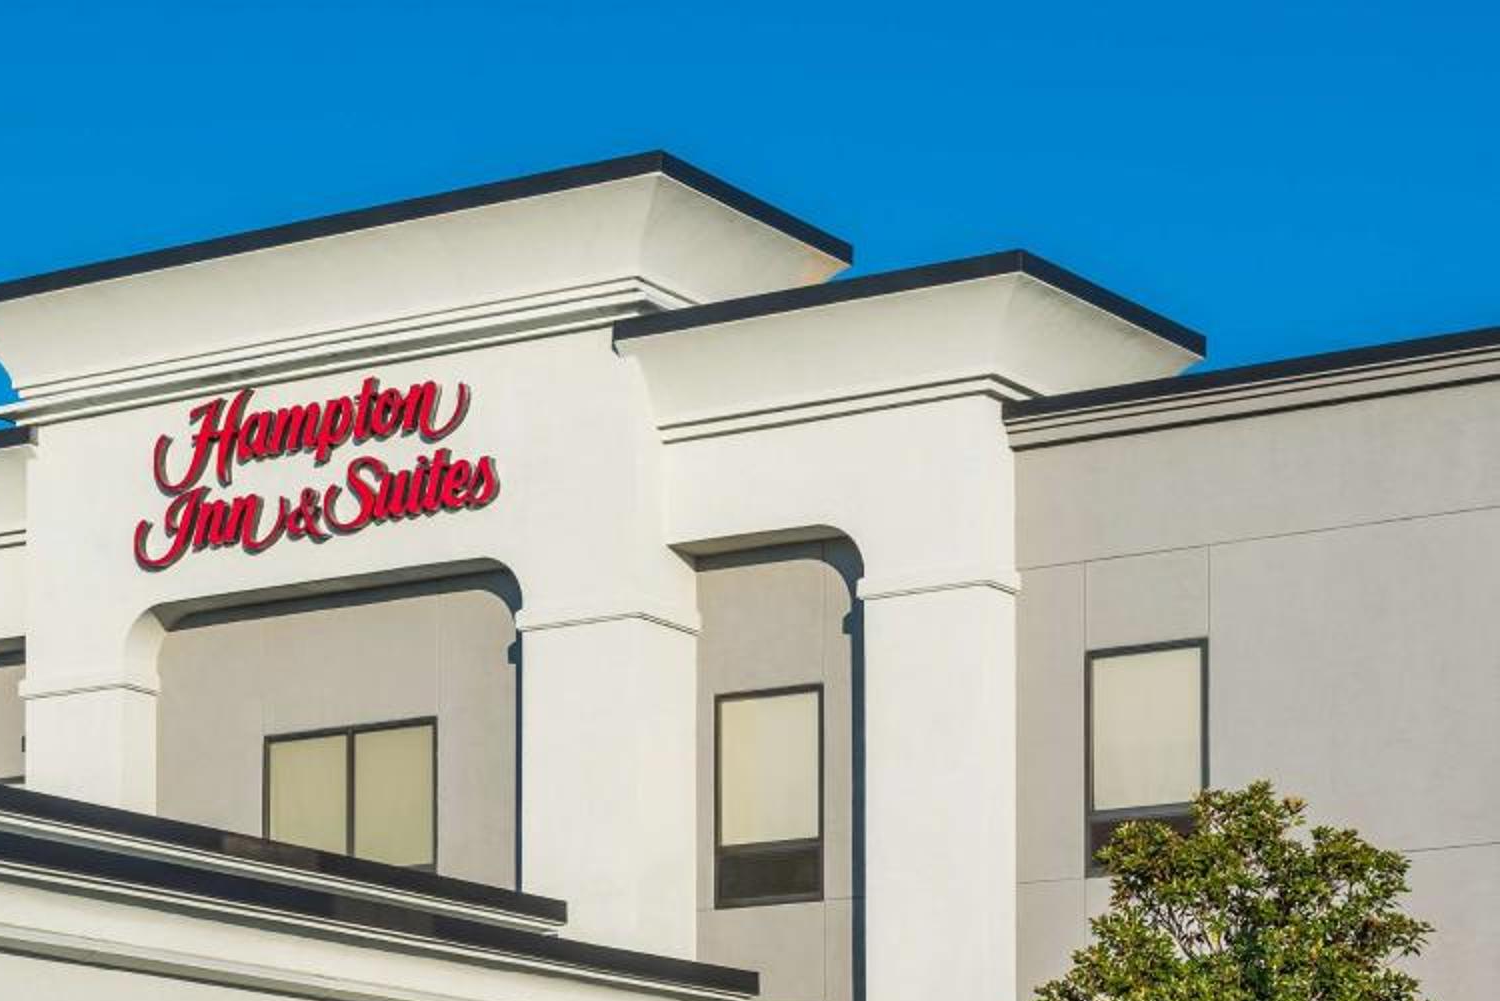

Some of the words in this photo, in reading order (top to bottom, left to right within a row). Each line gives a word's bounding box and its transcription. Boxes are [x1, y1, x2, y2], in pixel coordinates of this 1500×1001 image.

[154, 375, 471, 495] Hampton
[133, 485, 288, 573] Inn
[287, 487, 331, 543] &
[324, 447, 500, 534] Suites
